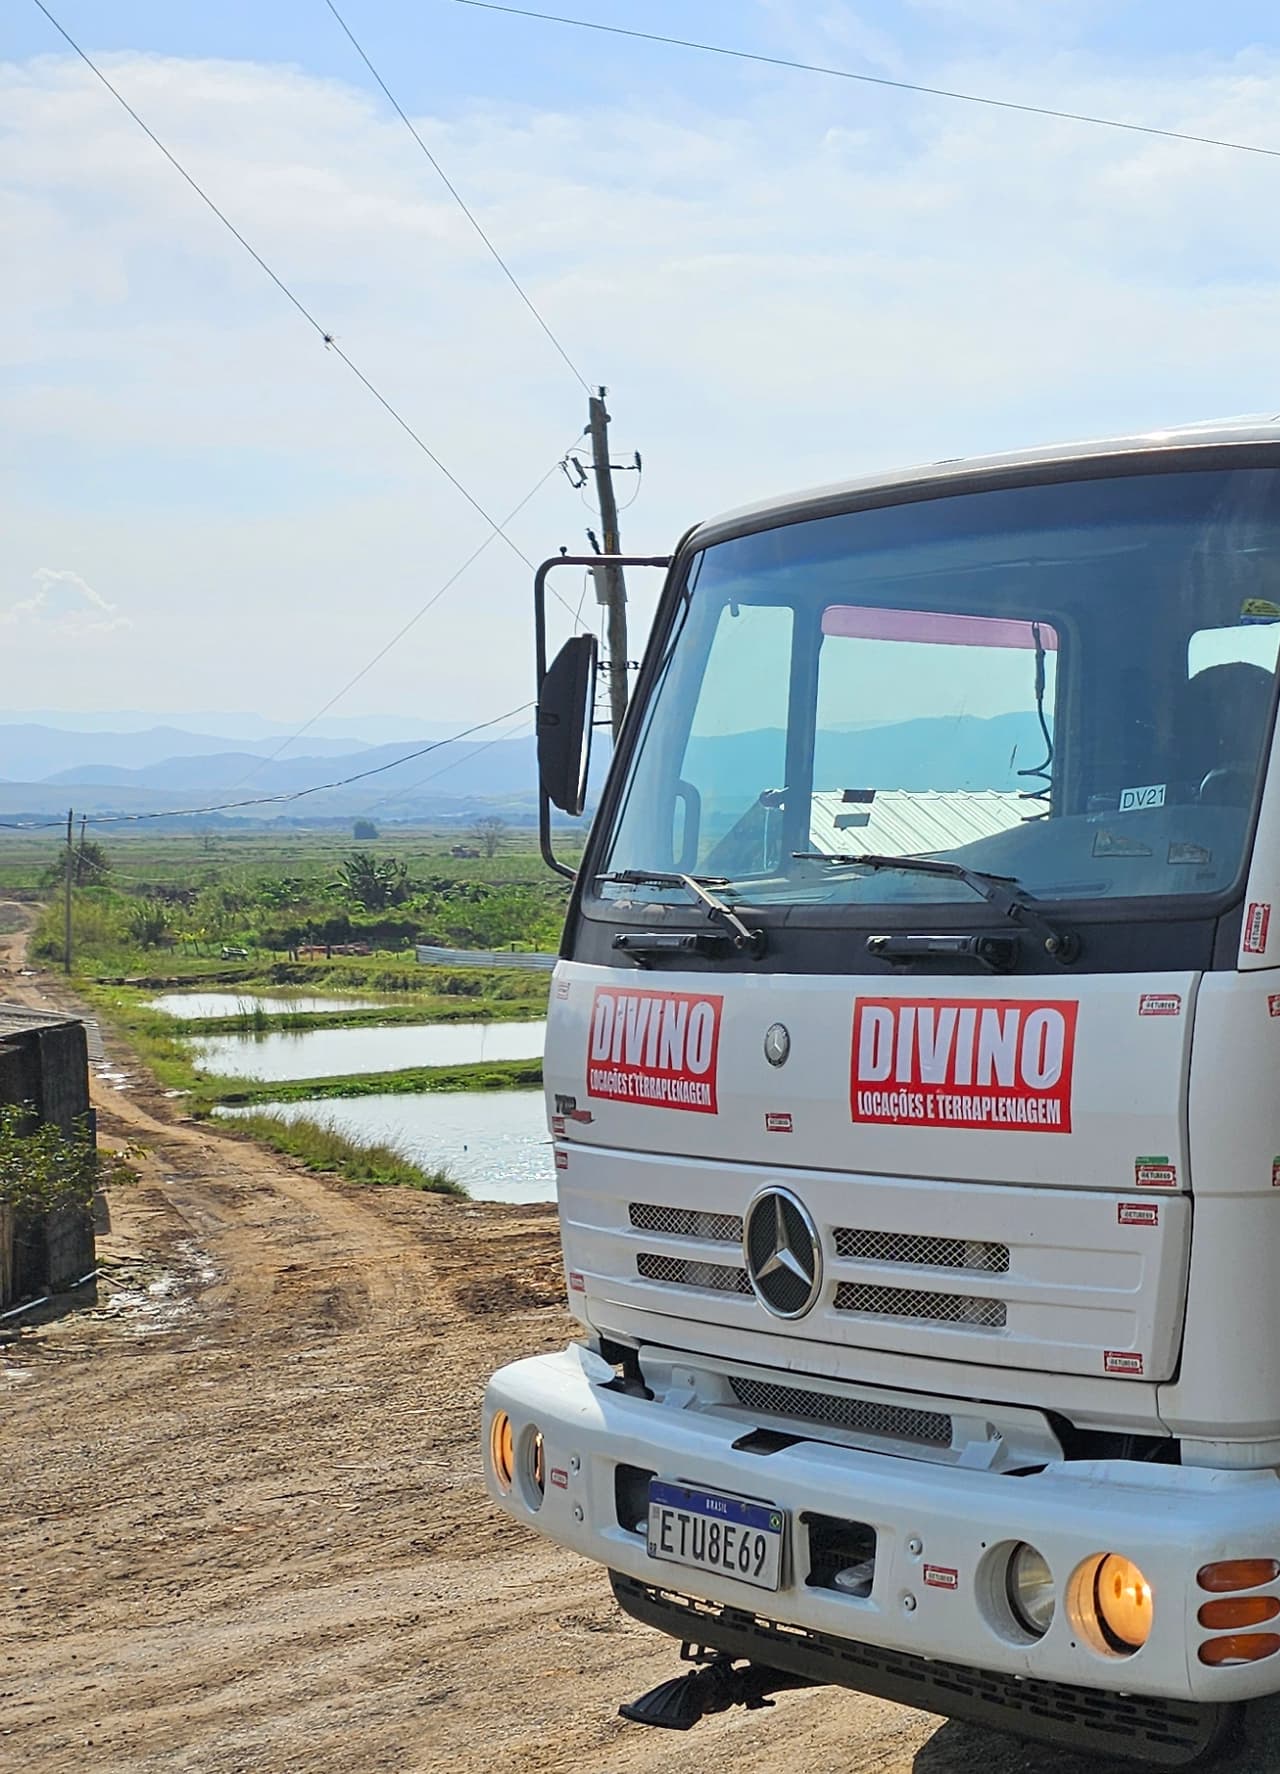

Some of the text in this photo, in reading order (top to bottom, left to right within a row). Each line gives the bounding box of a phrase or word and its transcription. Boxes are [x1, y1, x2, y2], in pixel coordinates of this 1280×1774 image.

[1123, 787, 1165, 809] DV21
[591, 993, 715, 1075] DIVINO
[857, 1005, 1066, 1090] DIVINO
[590, 1067, 712, 1106] LOCAÇÕES E TERRAPLENAGEM
[857, 1088, 1062, 1125] LOCAÇÕES E TERRAPLENAGEM
[705, 1498, 728, 1514] BRASIL
[660, 1509, 767, 1578] ETU8E69
